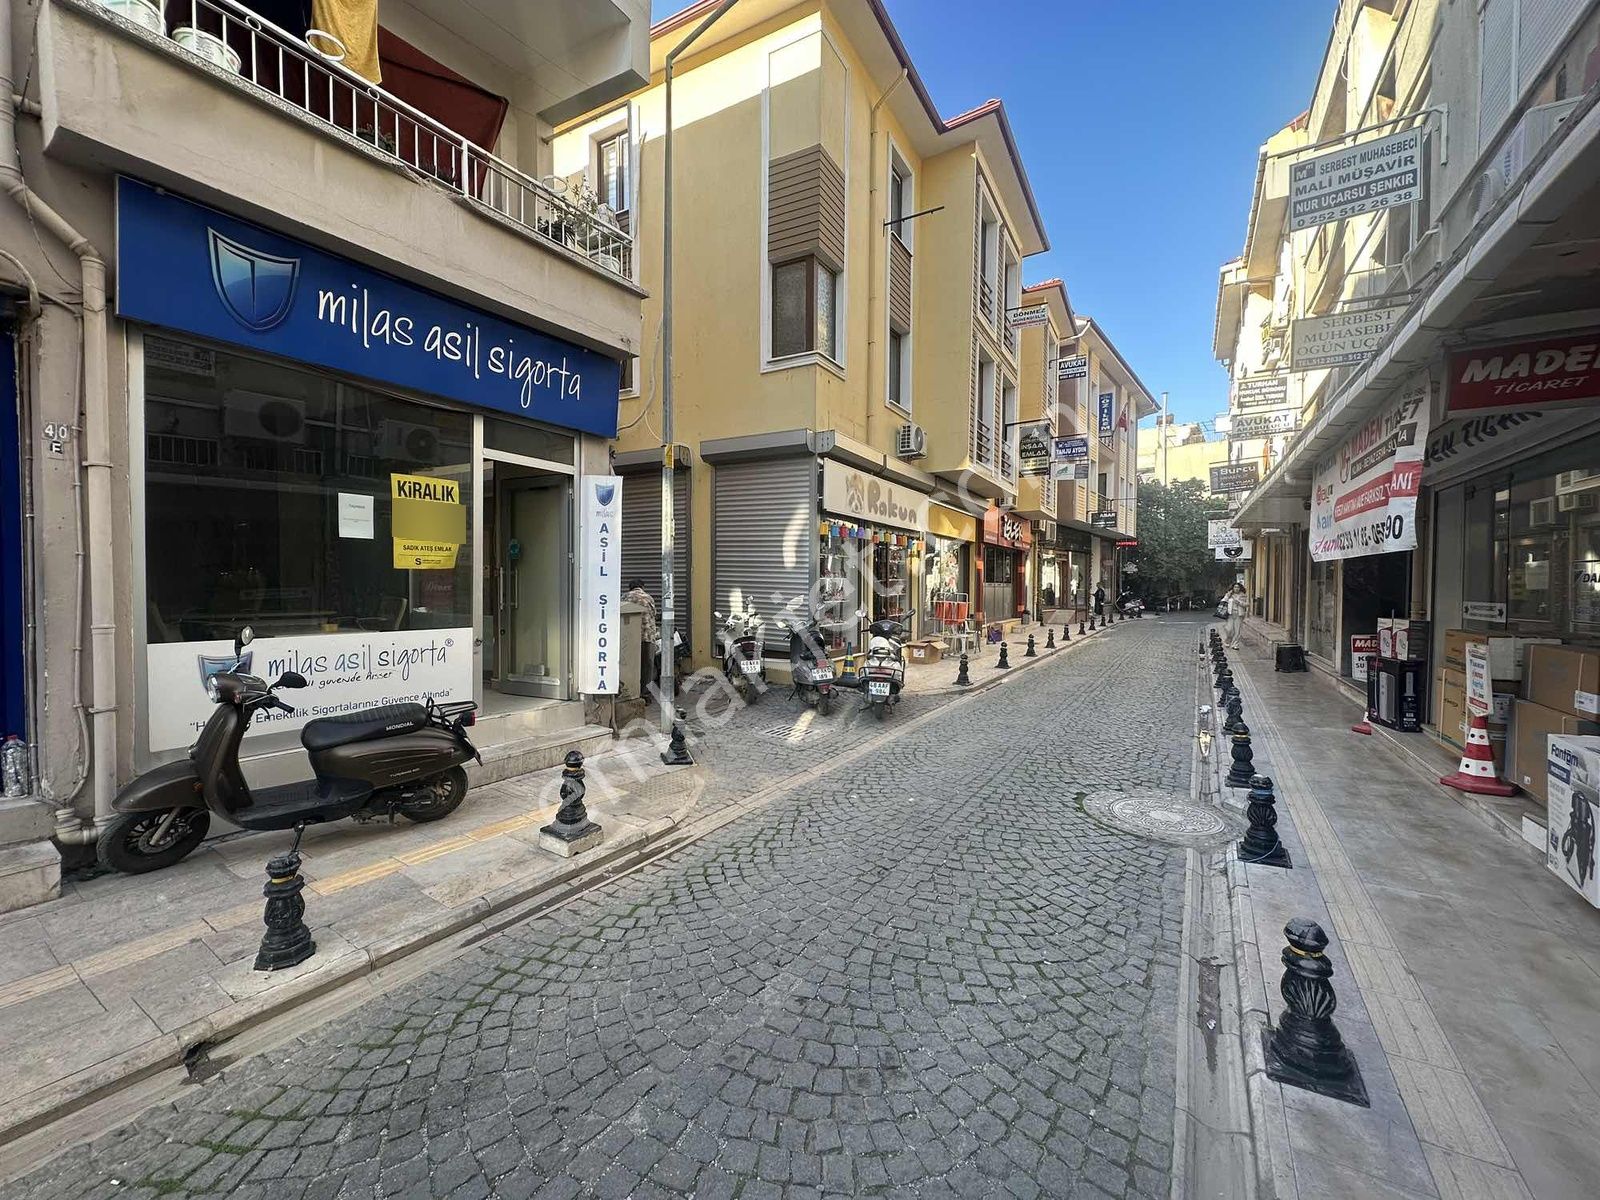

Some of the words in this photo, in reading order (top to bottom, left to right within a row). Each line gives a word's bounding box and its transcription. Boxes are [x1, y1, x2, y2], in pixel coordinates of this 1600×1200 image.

[1320, 155, 1357, 175] SERBEST
[1338, 154, 1416, 185] MÜŞAVİR
[1296, 200, 1319, 214] NUR
[1321, 186, 1367, 207] UÇARSU
[1309, 211, 1335, 225] 252
[1339, 203, 1366, 216] 512
[1371, 197, 1389, 209] 26
[1322, 309, 1396, 329] SERBEST
[318, 283, 414, 349] milas
[424, 322, 480, 380] asil
[488, 338, 581, 409] sigorta
[1060, 360, 1085, 369] AVUKAT
[1461, 344, 1600, 384] MADE
[45, 424, 67, 439] 40
[1236, 414, 1290, 428] AVUKAT
[867, 479, 917, 524] Rakun
[597, 594, 608, 691] SİGORTA
[268, 643, 328, 678] milas
[334, 643, 372, 677] asil
[385, 721, 414, 731] MONDIAL
